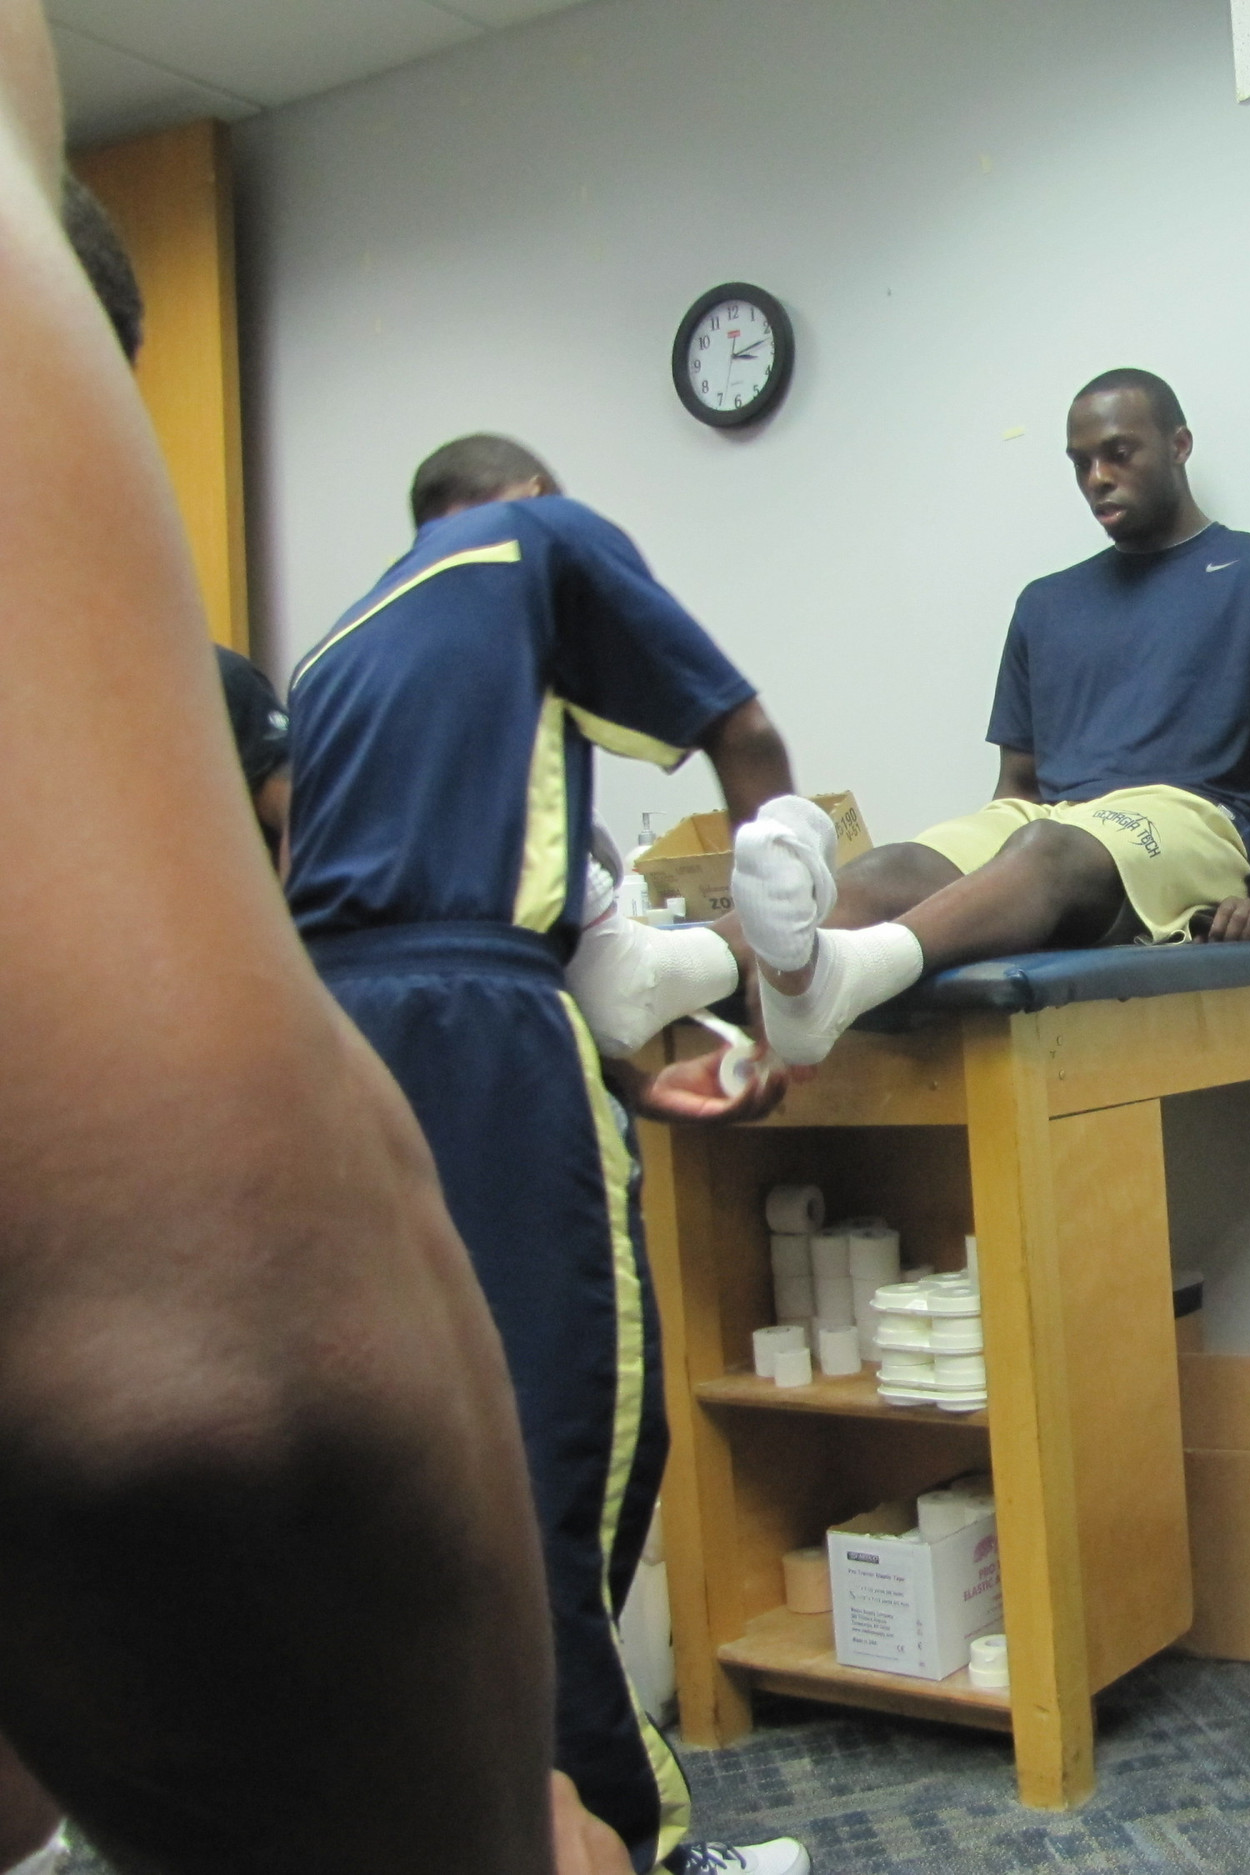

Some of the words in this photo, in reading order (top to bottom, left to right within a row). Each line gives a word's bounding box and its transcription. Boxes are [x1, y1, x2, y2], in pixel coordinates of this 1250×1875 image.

[728, 305, 740, 320] 12
[750, 307, 756, 321] 1
[711, 317, 720, 331] 11
[763, 321, 771, 334] 2
[699, 335, 710, 350] 10
[694, 359, 701, 373] 9
[702, 380, 709, 394] 8
[753, 384, 760, 398] 5
[717, 392, 723, 406] 7
[734, 394, 742, 408] 6
[1093, 809, 1141, 832] GEORGIA
[1137, 828, 1161, 859] TECH
